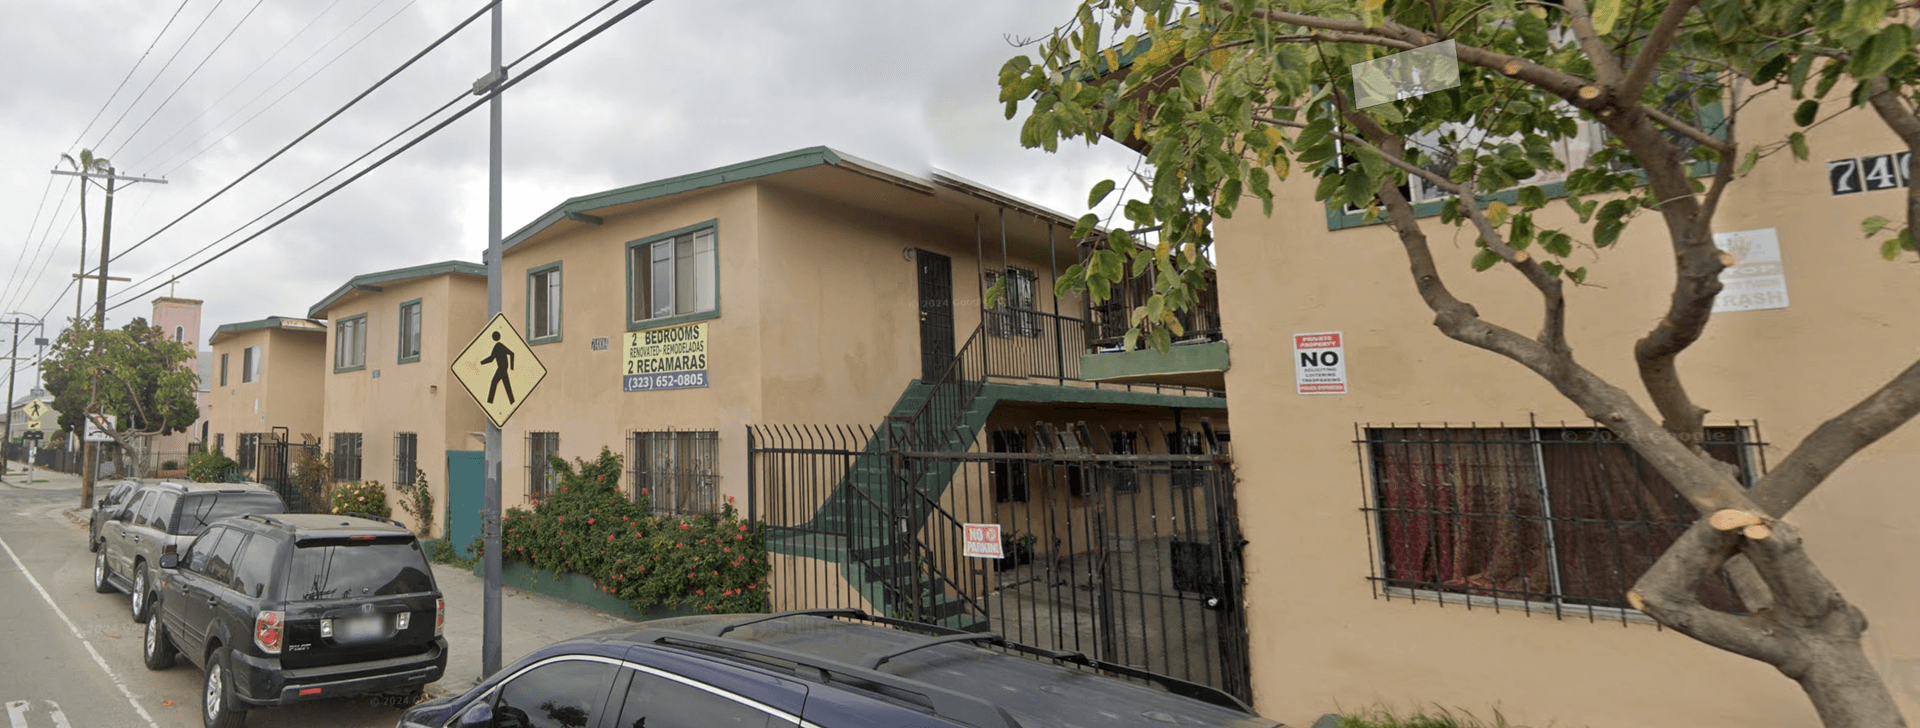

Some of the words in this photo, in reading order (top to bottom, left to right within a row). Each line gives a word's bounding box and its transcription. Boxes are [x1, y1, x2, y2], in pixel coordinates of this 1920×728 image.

[1716, 290, 1783, 308] RASH
[631, 333, 638, 346] 2
[645, 325, 700, 345] BEDROOMS
[663, 340, 704, 356] REMODELADAS
[627, 360, 634, 374] 2
[637, 354, 706, 373] RECAMARAS
[1300, 351, 1339, 367] NO
[628, 376, 654, 391] (323)
[656, 373, 703, 387] 652-0805
[969, 527, 984, 541] NO
[967, 541, 1000, 553] PARKING
